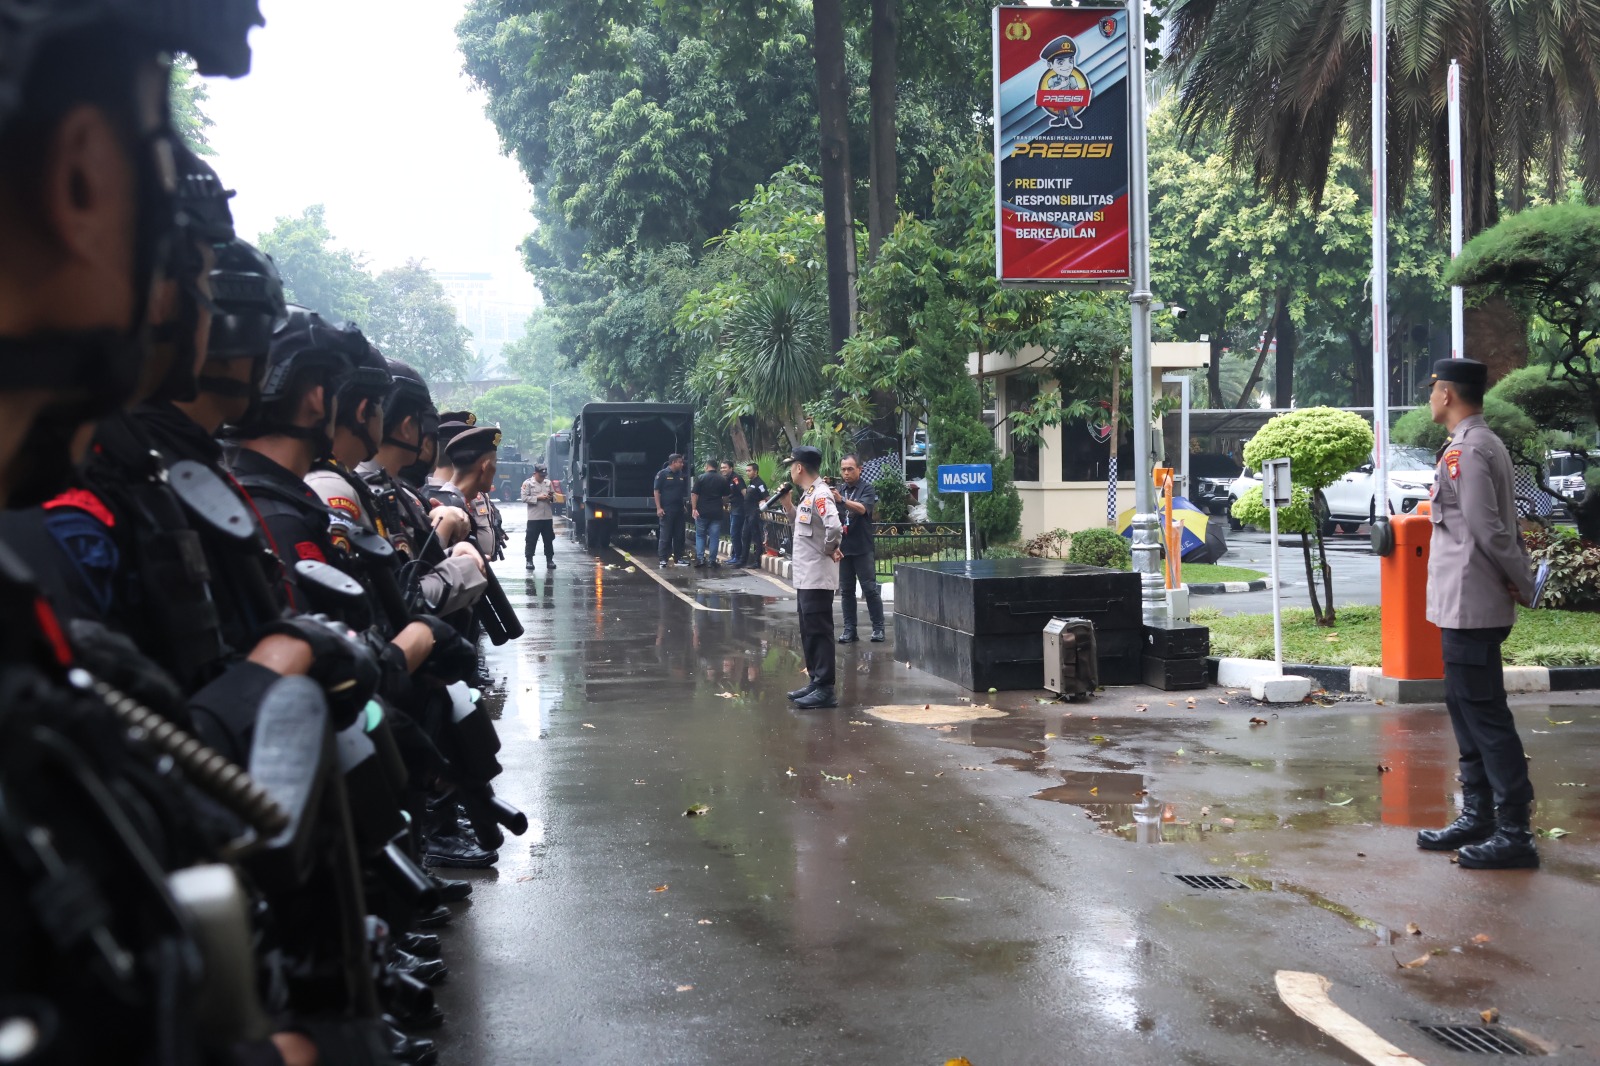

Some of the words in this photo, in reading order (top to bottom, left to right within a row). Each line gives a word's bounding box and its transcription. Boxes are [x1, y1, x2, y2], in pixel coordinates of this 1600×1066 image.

[1042, 95, 1084, 103] PRESISI
[1011, 143, 1114, 158] PRESISI
[1014, 178, 1073, 189] PREDIKTIF
[1015, 195, 1114, 206] RESPONSIBILITAS
[1015, 211, 1104, 222] TRANSPARANSI
[1015, 227, 1096, 239] BERKEADILAN
[943, 472, 986, 485] MASUK
